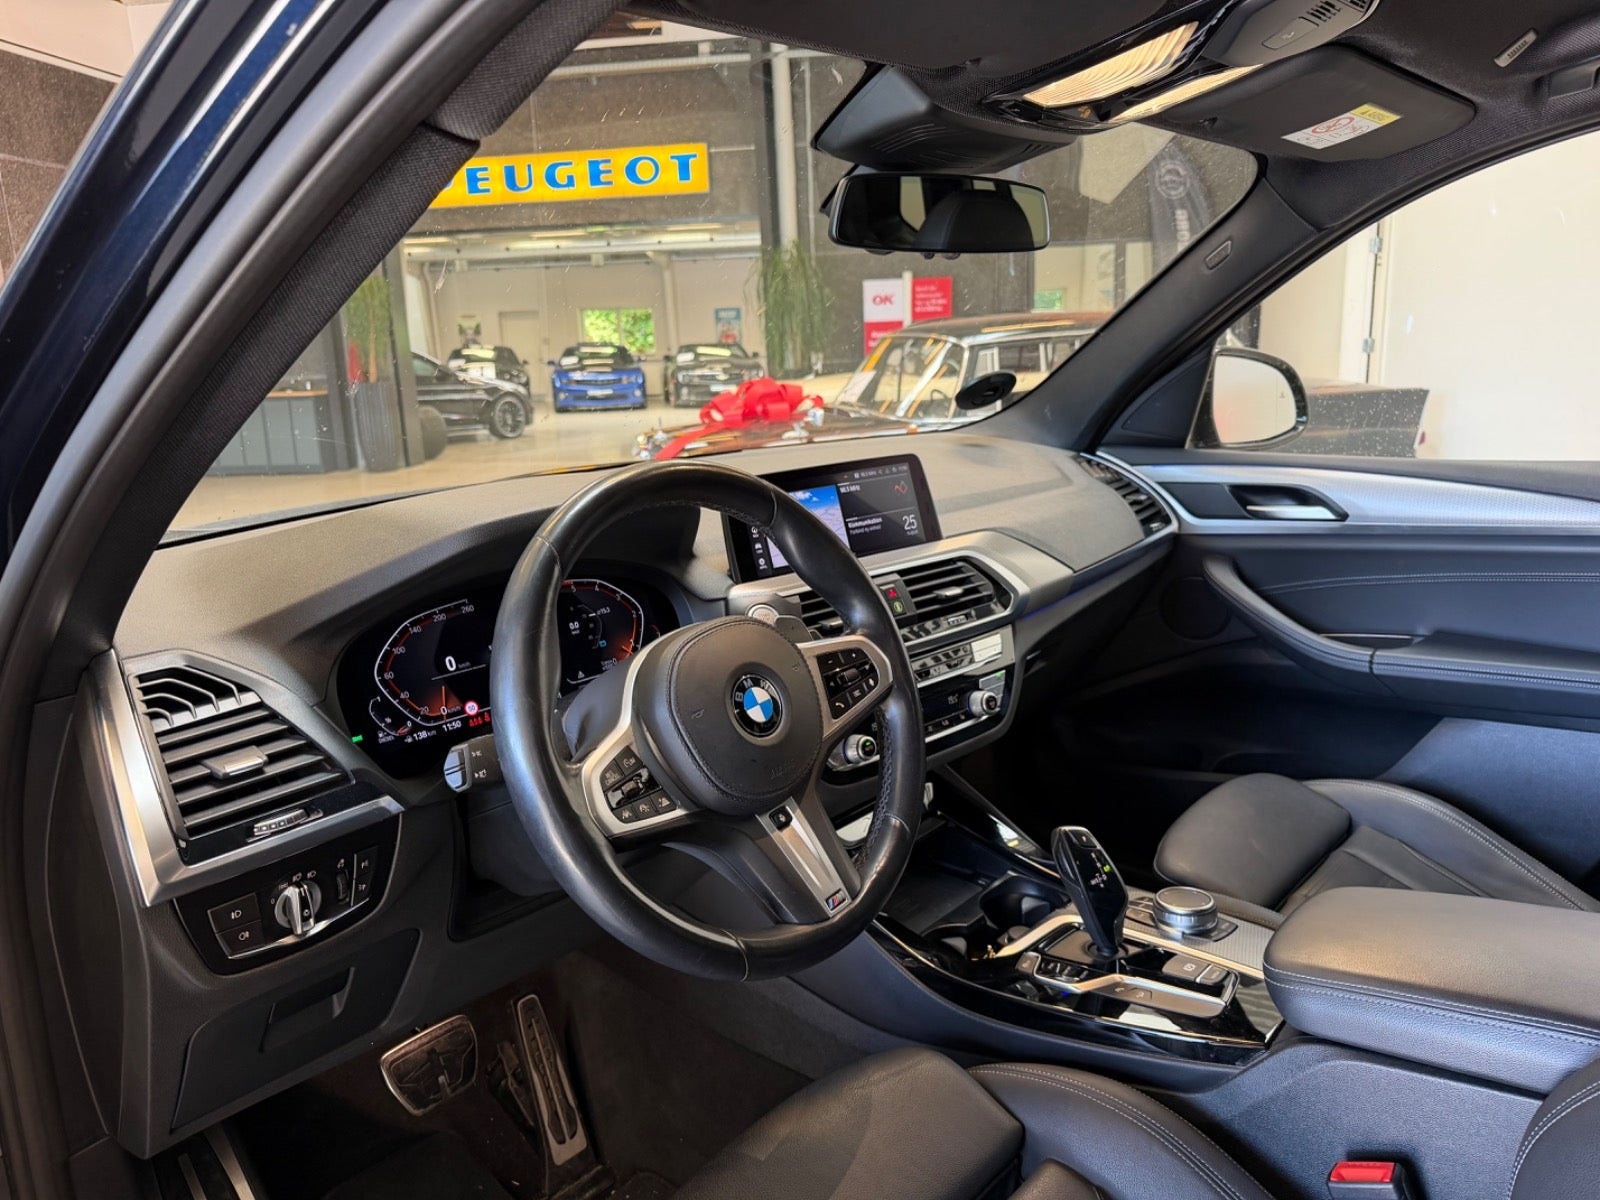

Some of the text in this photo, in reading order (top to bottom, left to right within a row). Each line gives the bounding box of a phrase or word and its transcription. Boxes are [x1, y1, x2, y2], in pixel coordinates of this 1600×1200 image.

[444, 153, 697, 195] EUGEOT
[872, 295, 895, 306] OK
[902, 514, 917, 530] 25
[461, 604, 475, 614] 260
[432, 613, 447, 623] 200
[408, 625, 421, 635] 140
[392, 646, 406, 656] 100
[445, 655, 457, 671] 0
[384, 671, 394, 680] 60
[400, 690, 410, 699] 40
[420, 705, 429, 715] 20
[440, 706, 448, 715] 0
[413, 730, 427, 741] 138
